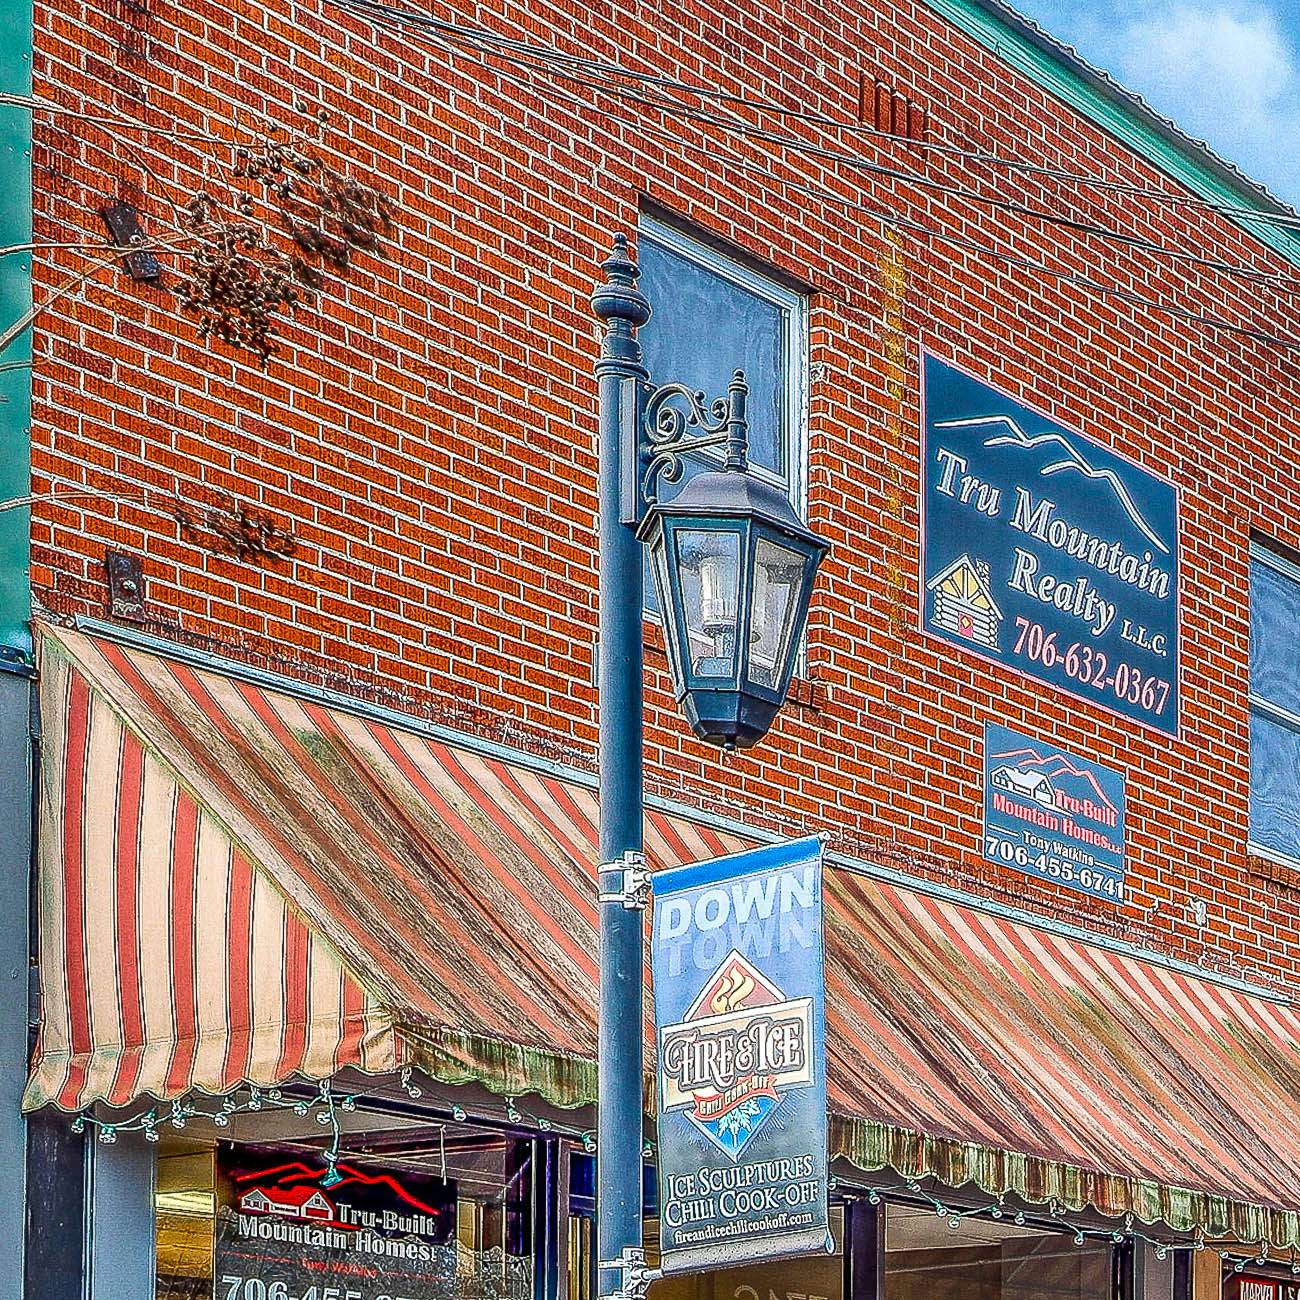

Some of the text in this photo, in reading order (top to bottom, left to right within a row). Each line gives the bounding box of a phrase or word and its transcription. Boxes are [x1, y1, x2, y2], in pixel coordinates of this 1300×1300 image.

[935, 447, 1171, 599] Tru Mountain
[1007, 547, 1169, 657] Realty L.L.C.
[1012, 616, 1171, 716] 706-632-0367
[992, 792, 1060, 832] Mountain
[1062, 818, 1109, 850] Homes
[1055, 788, 1118, 828] Tru-Built
[985, 835, 1125, 900] 706-455-6741
[1023, 830, 1095, 867] Tony Watkins
[660, 866, 816, 941] DOWN
[660, 915, 815, 977] TOWN
[665, 1180, 820, 1227] CHILI COOK-OFF
[668, 1154, 814, 1202] ICE SCULPTURES
[238, 1214, 347, 1251] Mountain
[336, 1202, 437, 1237] Tru-Built
[674, 1212, 813, 1244] fireandicechilicookoff.com
